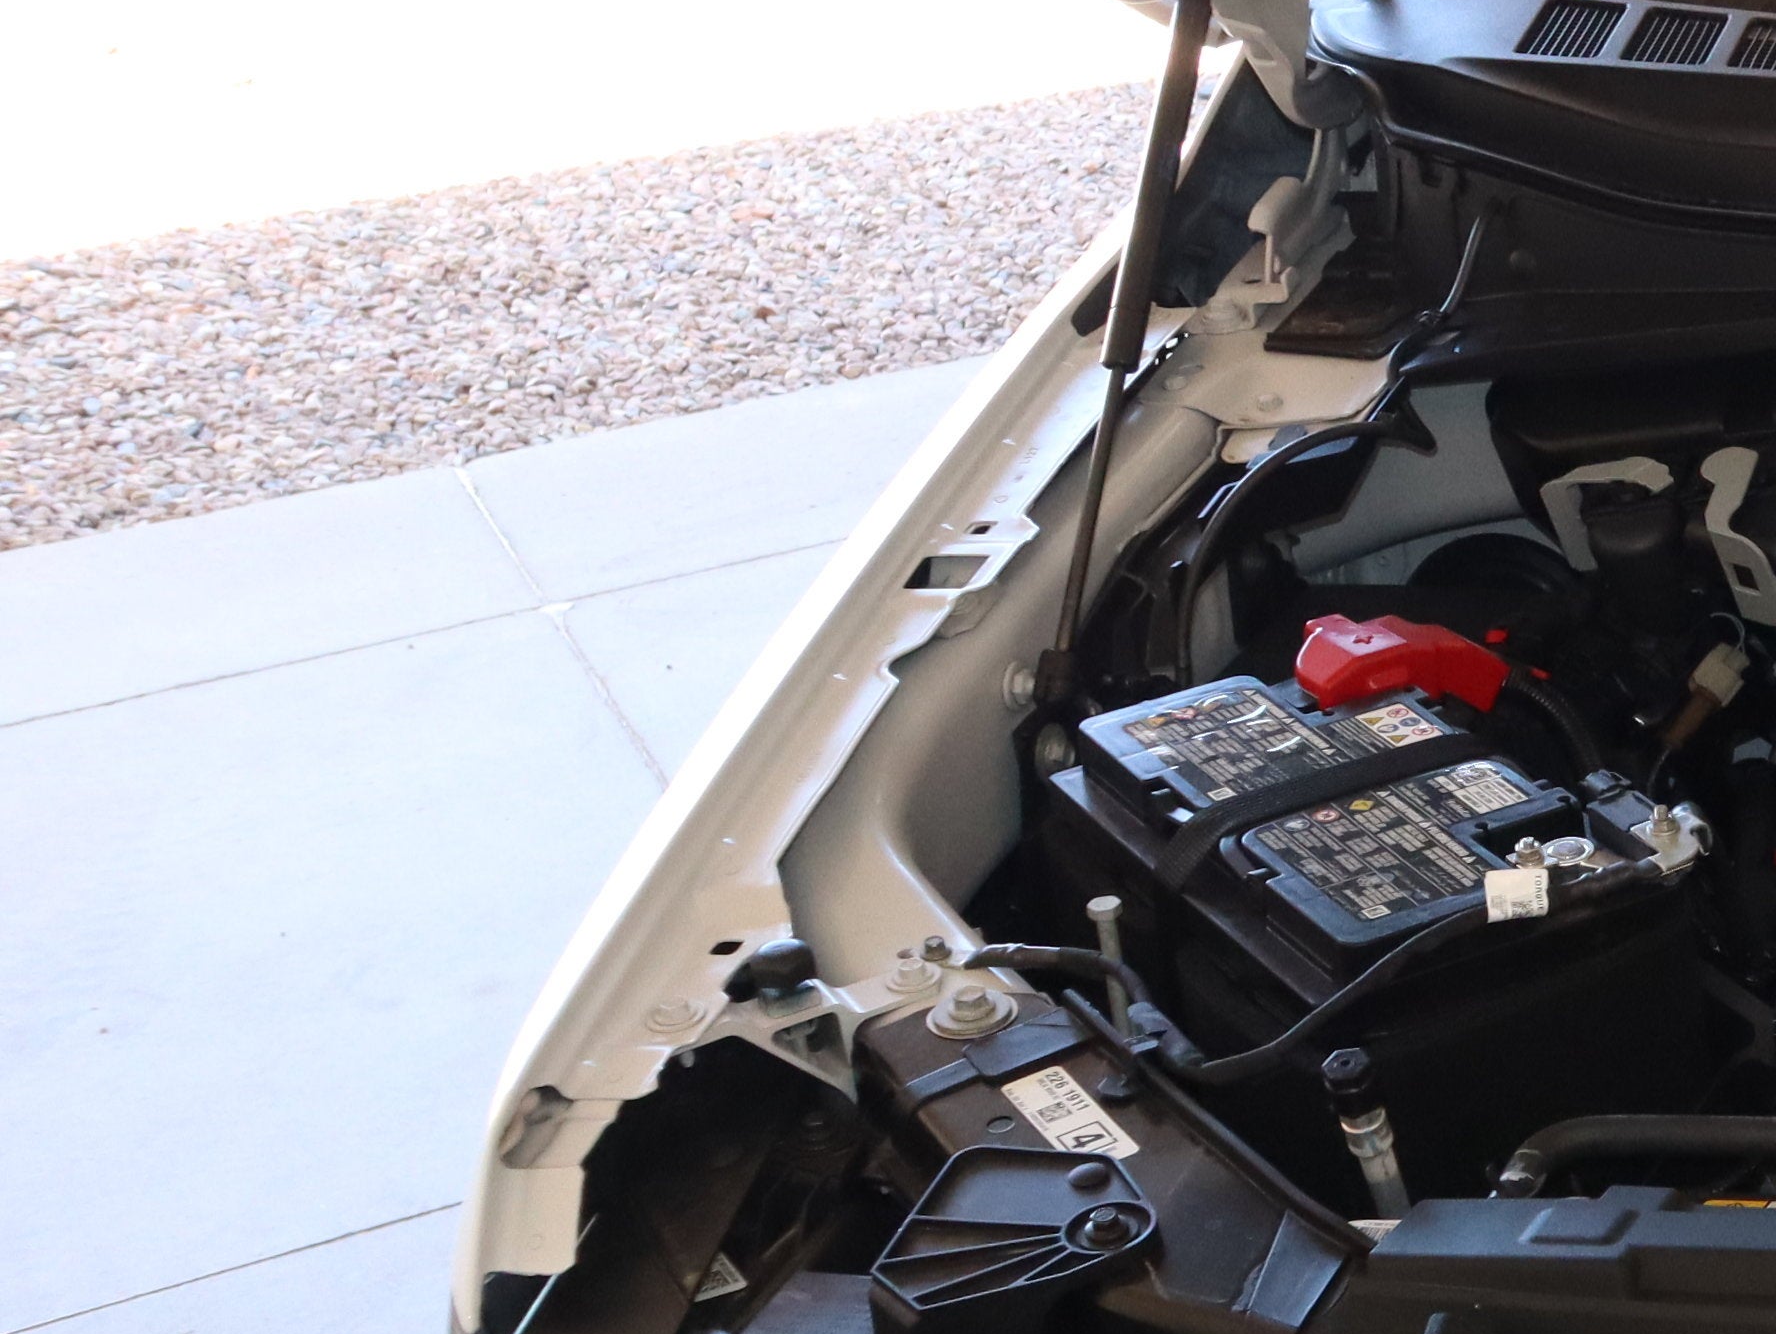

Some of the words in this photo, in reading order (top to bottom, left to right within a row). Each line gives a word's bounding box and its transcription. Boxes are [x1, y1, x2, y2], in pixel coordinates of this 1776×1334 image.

[1045, 1071, 1069, 1089] 226
[1062, 1090, 1091, 1111] 1911
[1071, 1133, 1106, 1149] 4
